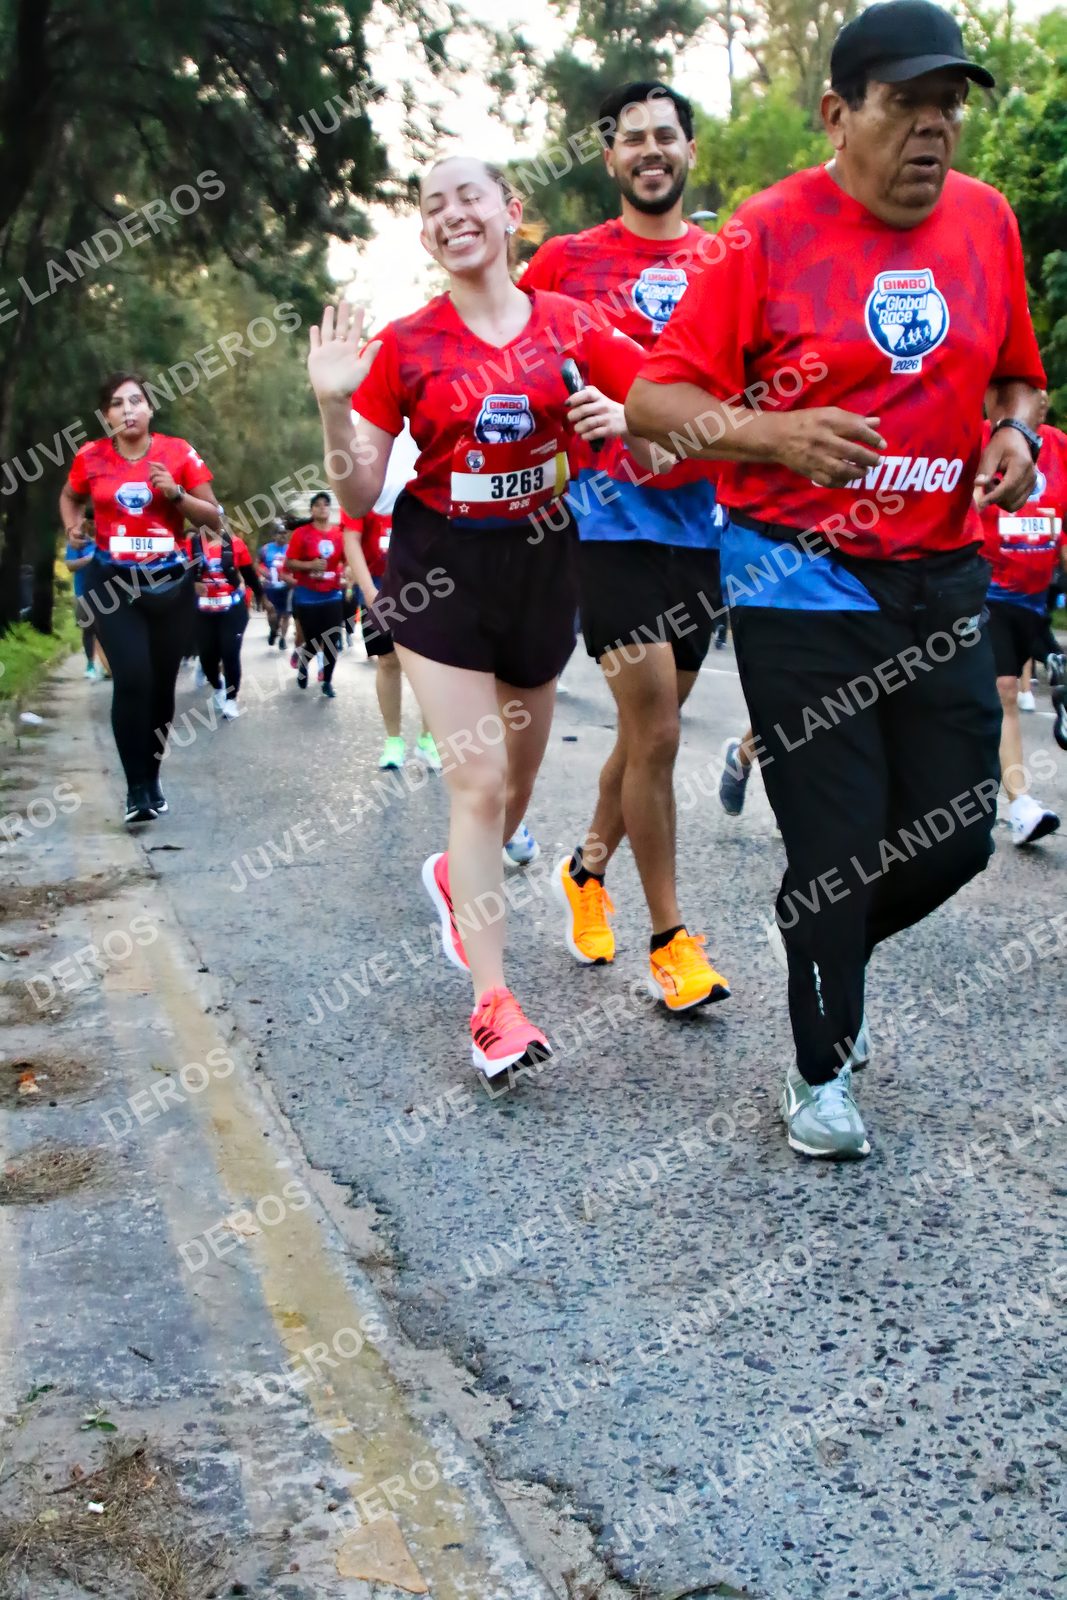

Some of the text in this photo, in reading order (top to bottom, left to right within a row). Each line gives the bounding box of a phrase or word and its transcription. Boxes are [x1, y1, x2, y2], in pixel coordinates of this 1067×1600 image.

[883, 279, 926, 290] BIMBO
[885, 295, 927, 311] Global
[879, 309, 913, 325] Race
[893, 360, 919, 371] 2026
[490, 401, 523, 410] BIMBO
[490, 413, 521, 425] Global
[811, 455, 964, 493] NTIAGO
[490, 466, 545, 500] 3263
[131, 538, 153, 550] 1914
